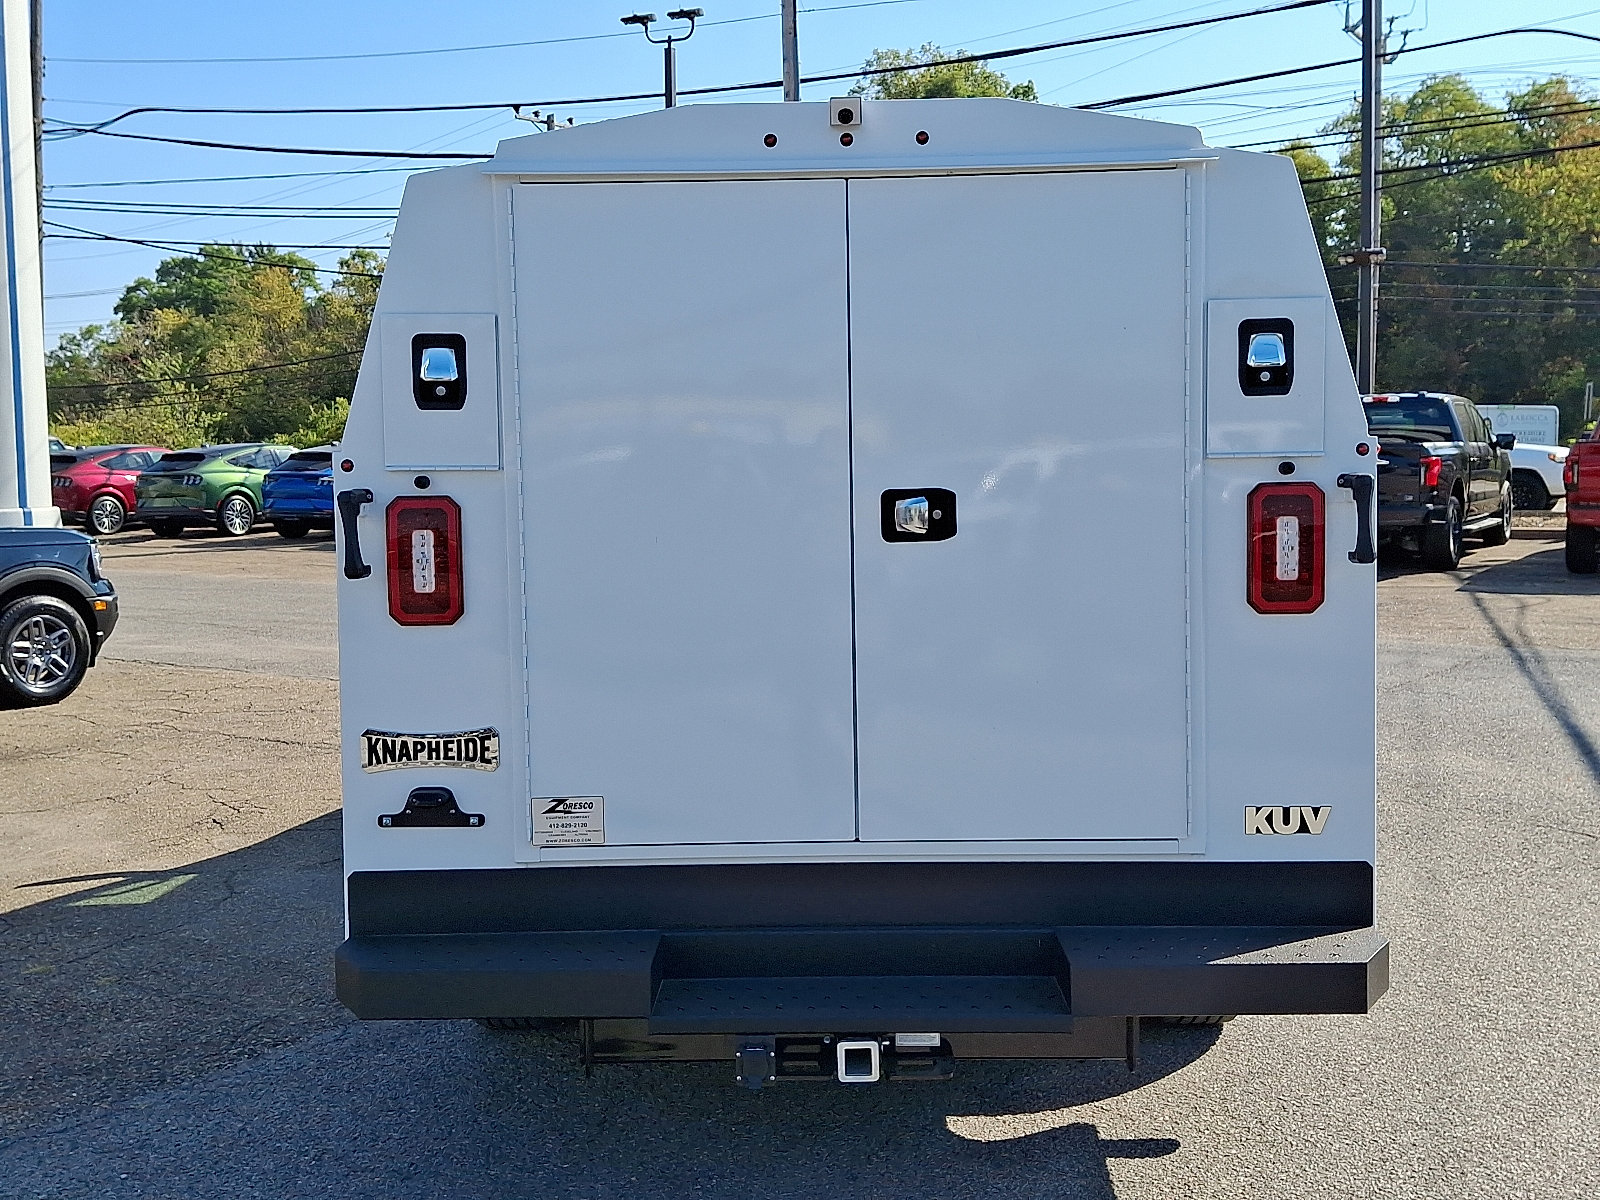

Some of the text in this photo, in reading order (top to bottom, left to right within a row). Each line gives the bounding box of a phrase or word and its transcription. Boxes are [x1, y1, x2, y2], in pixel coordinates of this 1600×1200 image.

[366, 734, 493, 767] KNAPHEIDE
[541, 798, 594, 815] ZORESCO
[1244, 805, 1332, 835] KUV
